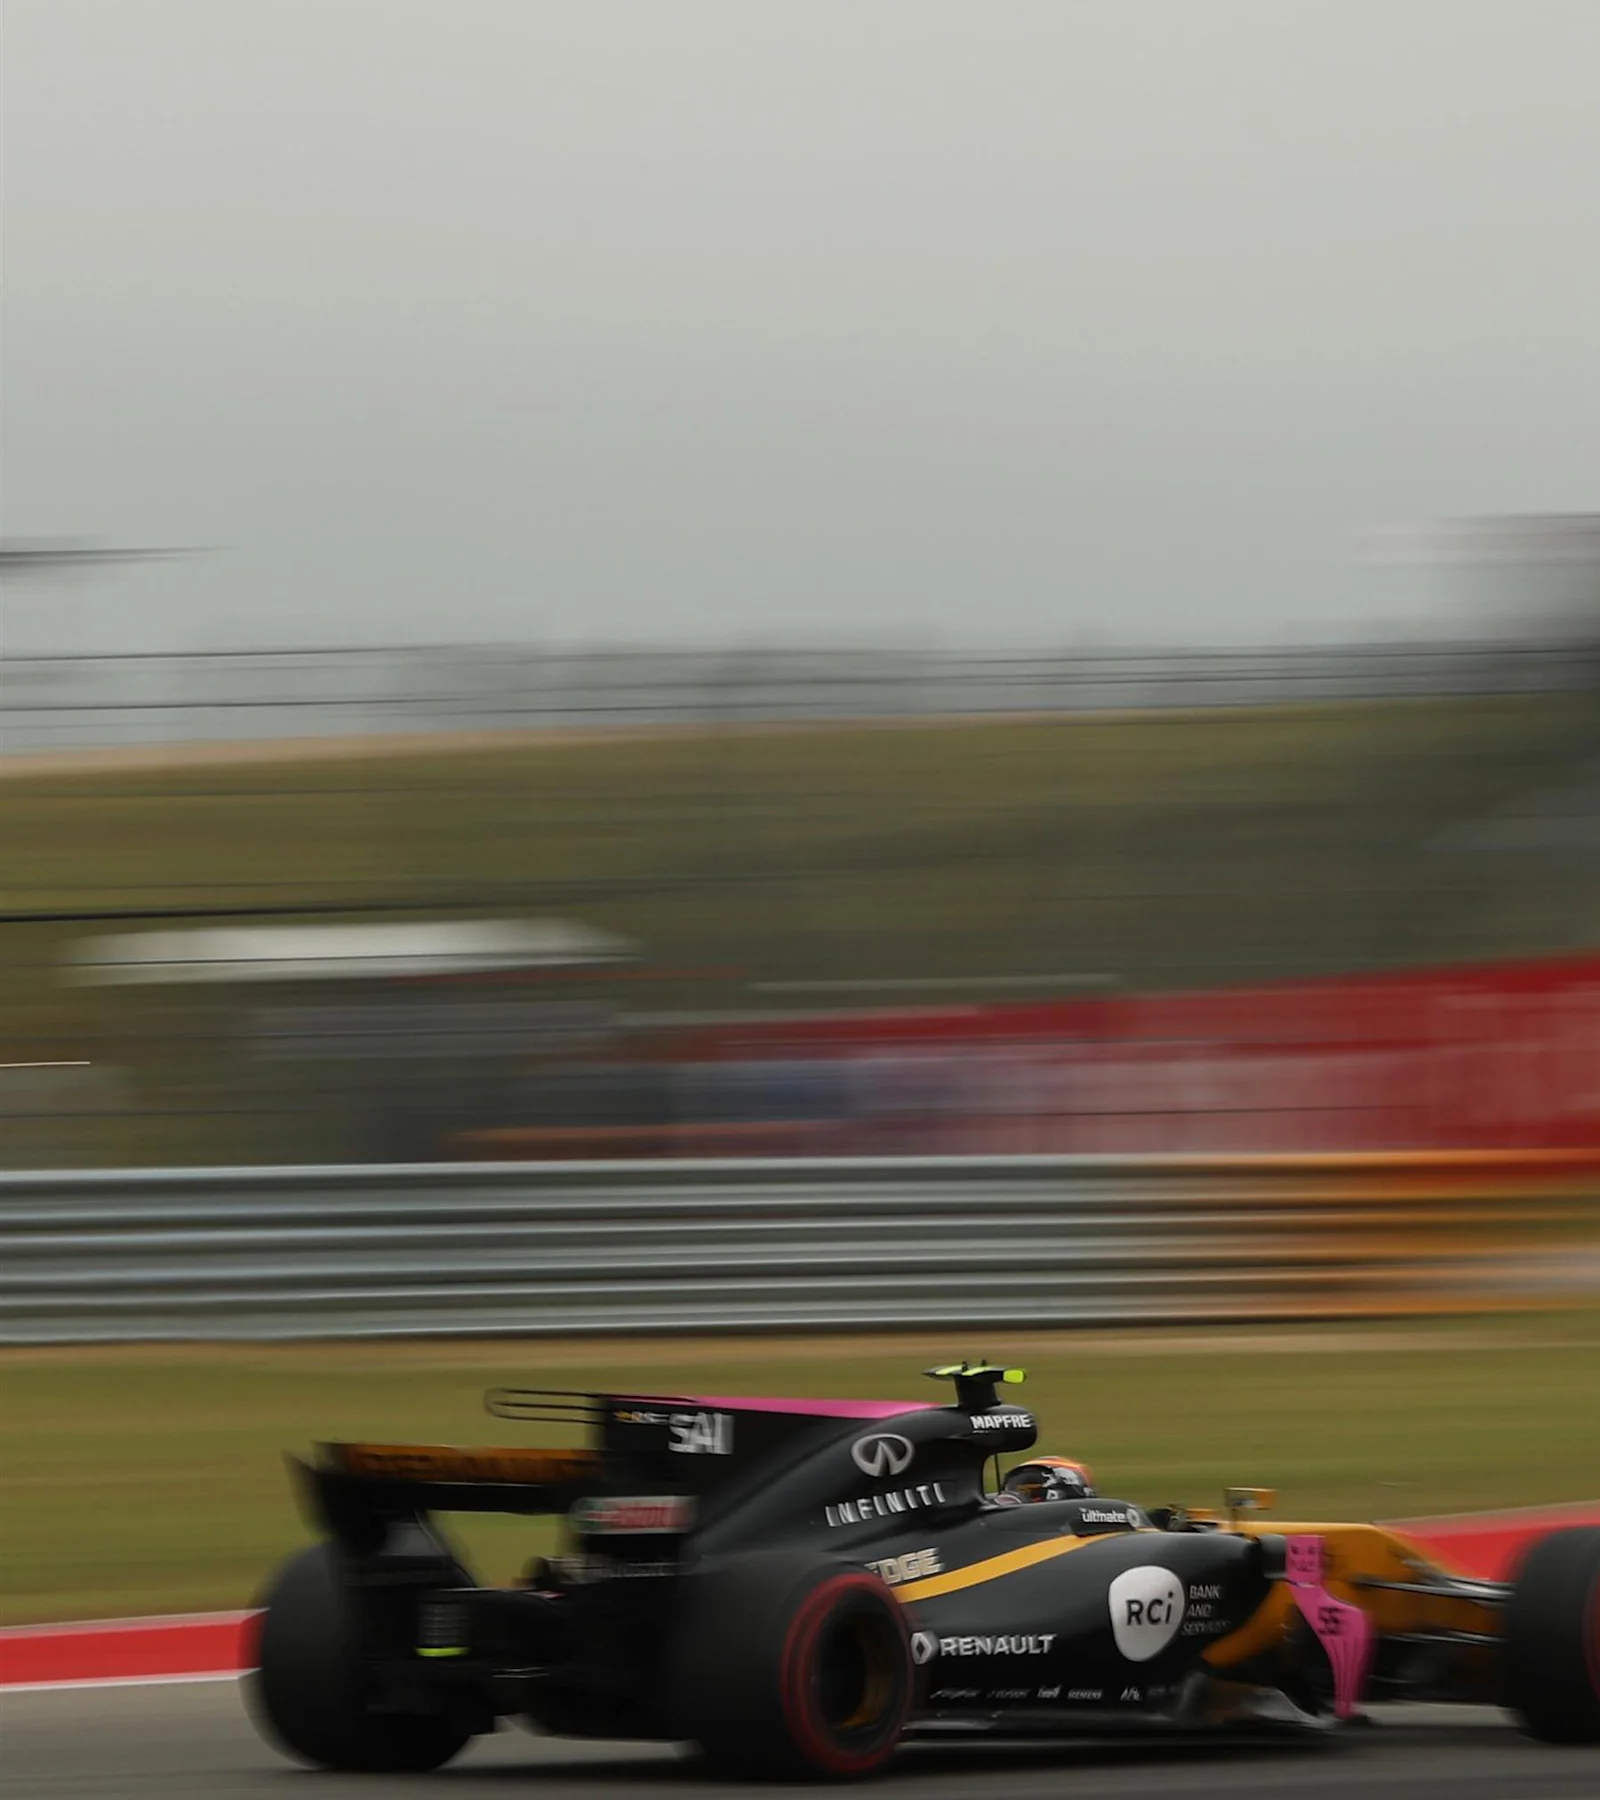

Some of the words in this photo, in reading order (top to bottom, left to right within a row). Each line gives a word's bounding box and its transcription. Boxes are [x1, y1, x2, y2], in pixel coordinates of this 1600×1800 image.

[970, 1413, 1034, 1429] MAPFRE
[825, 1482, 946, 1527] INFINITI
[1189, 1584, 1221, 1599] BANK
[1126, 1590, 1173, 1626] RCi
[1187, 1604, 1212, 1618] AND
[939, 1634, 1057, 1656] RENAULT
